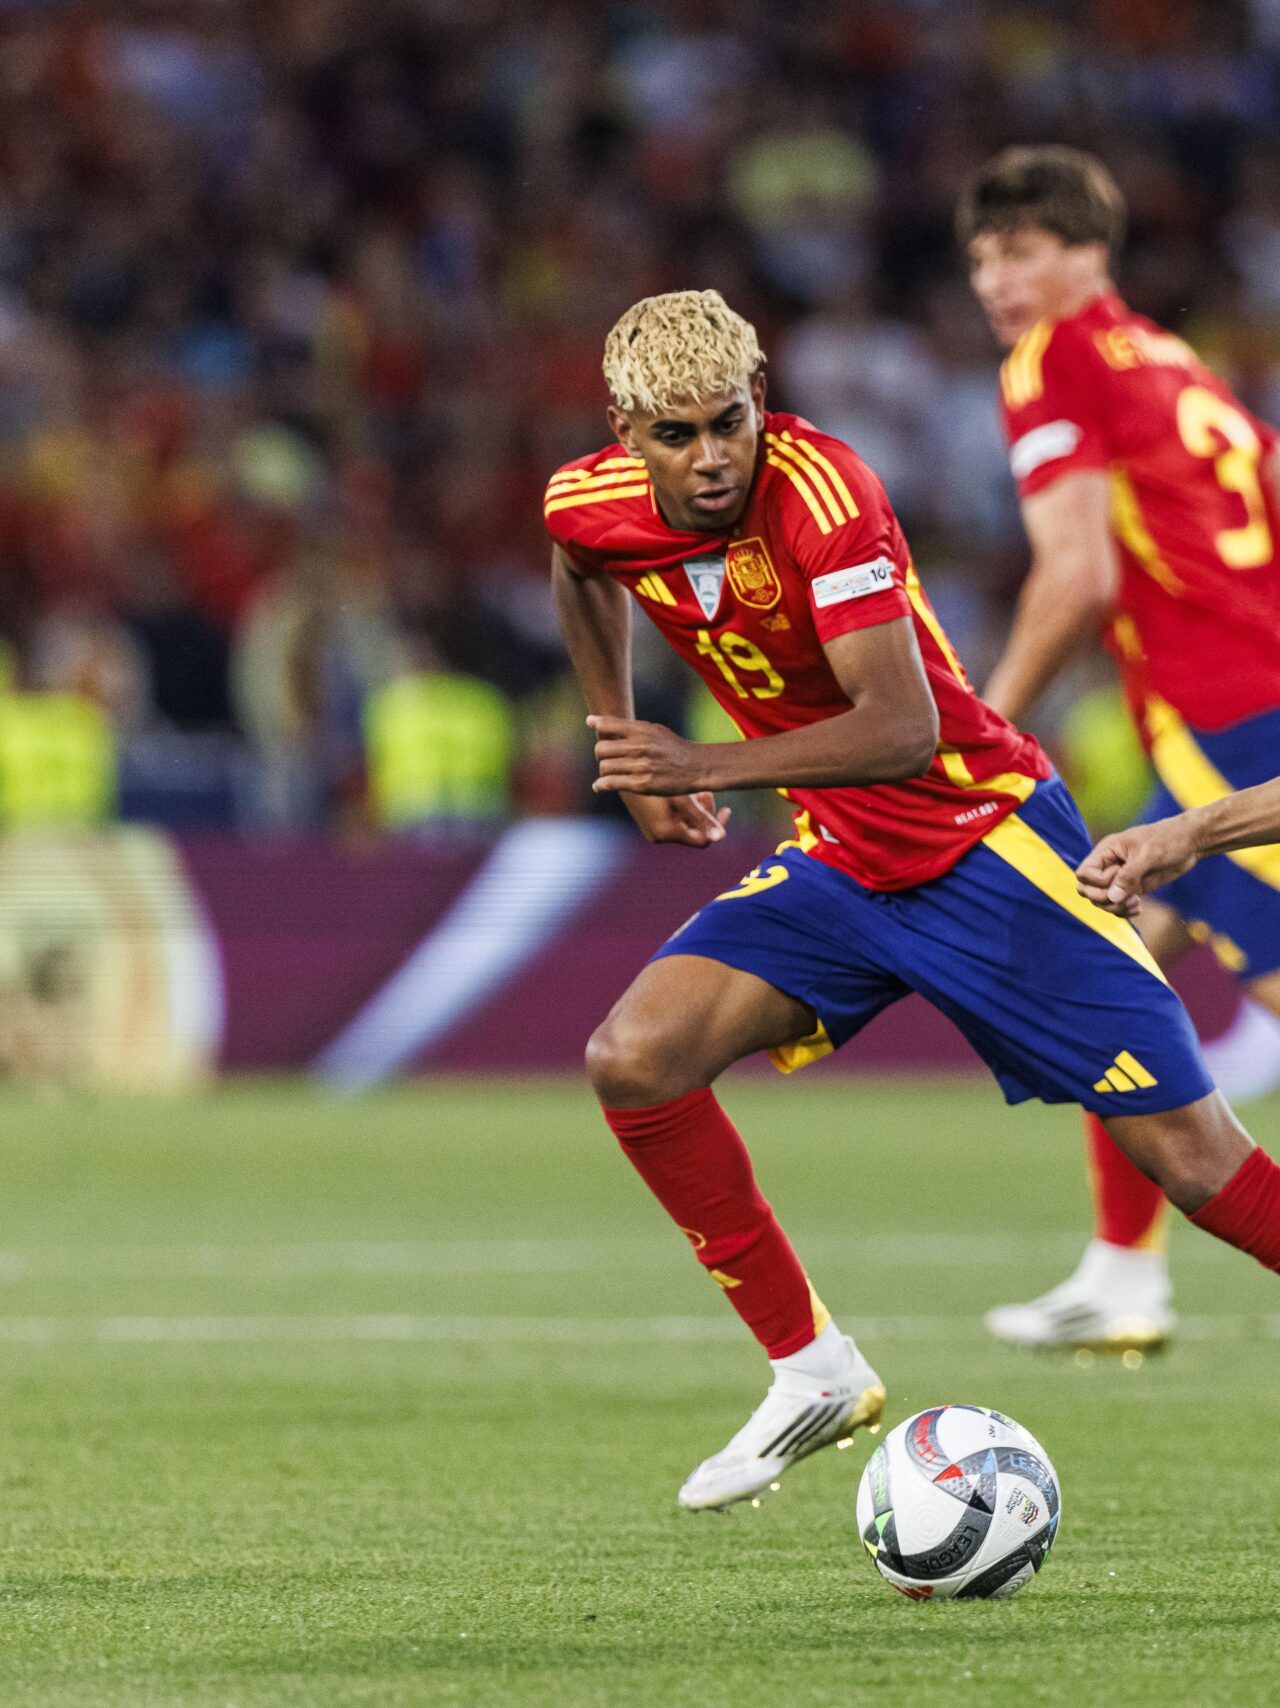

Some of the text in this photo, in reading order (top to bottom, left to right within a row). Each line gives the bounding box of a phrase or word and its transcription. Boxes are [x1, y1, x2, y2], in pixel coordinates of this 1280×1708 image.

[1176, 386, 1273, 570] 3
[695, 629, 785, 699] 19
[919, 1525, 979, 1574] LEAGUE
